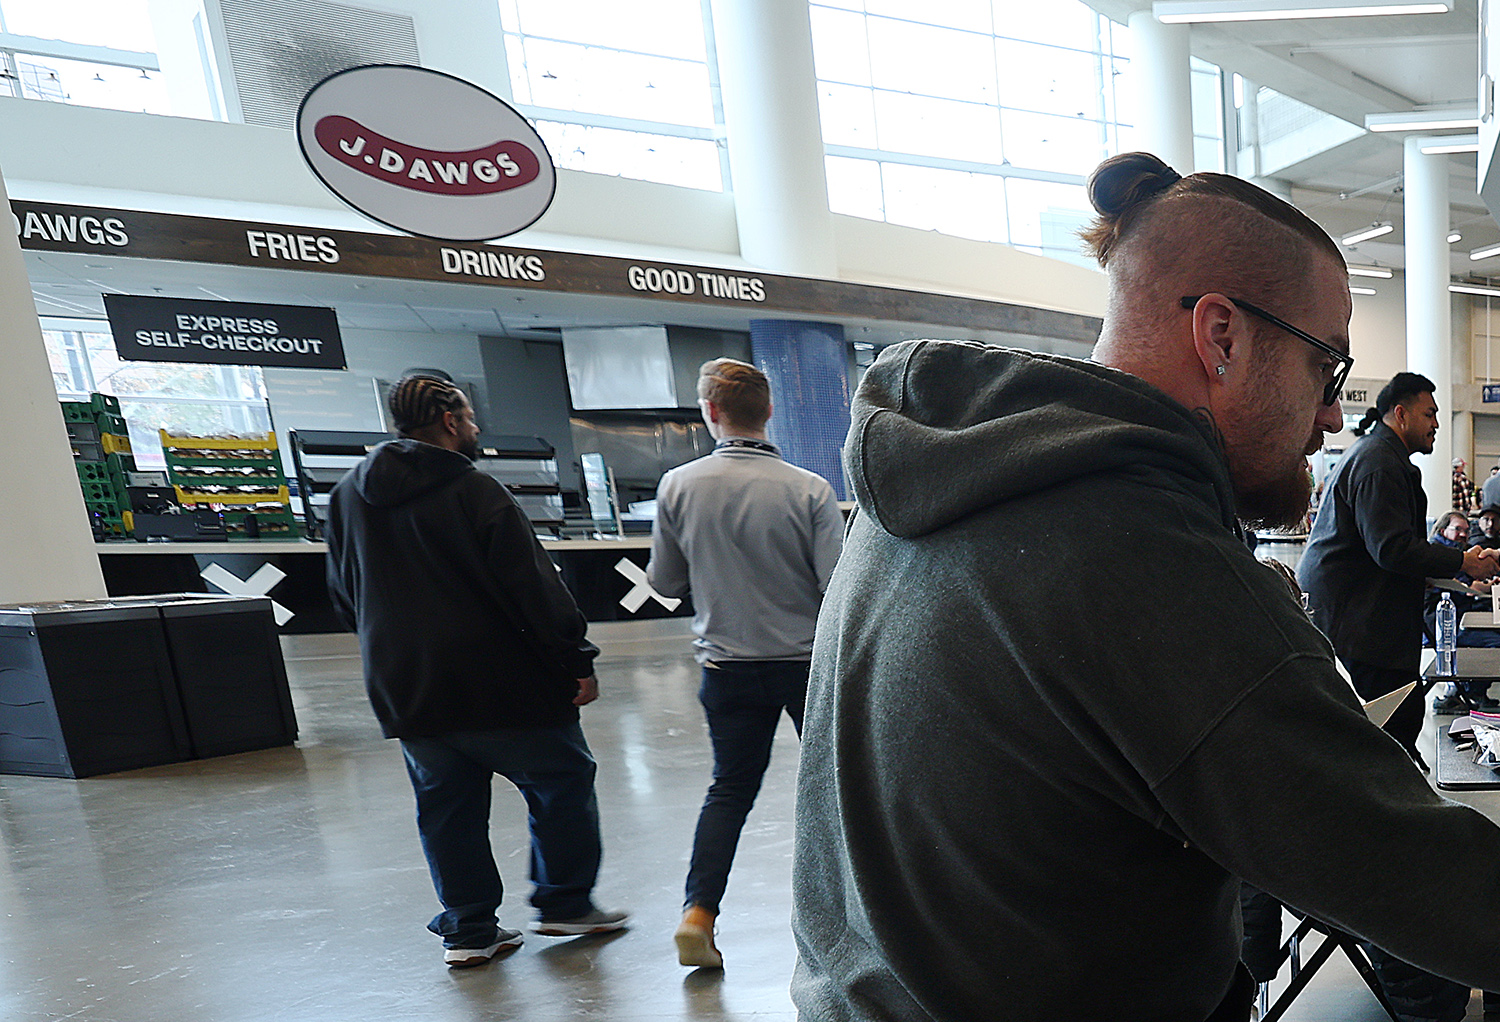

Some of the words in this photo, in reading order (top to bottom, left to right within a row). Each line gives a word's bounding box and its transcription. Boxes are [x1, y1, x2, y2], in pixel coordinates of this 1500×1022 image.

[338, 135, 521, 185] J.DAWGS
[246, 229, 340, 264] FRIES
[440, 247, 546, 282] DRINKS
[627, 265, 696, 295] GOOD
[696, 271, 767, 302] TIMES
[135, 329, 324, 355] SELF-CHECKOUT
[175, 313, 280, 336] EXPRESS
[1345, 389, 1368, 402] WEST
